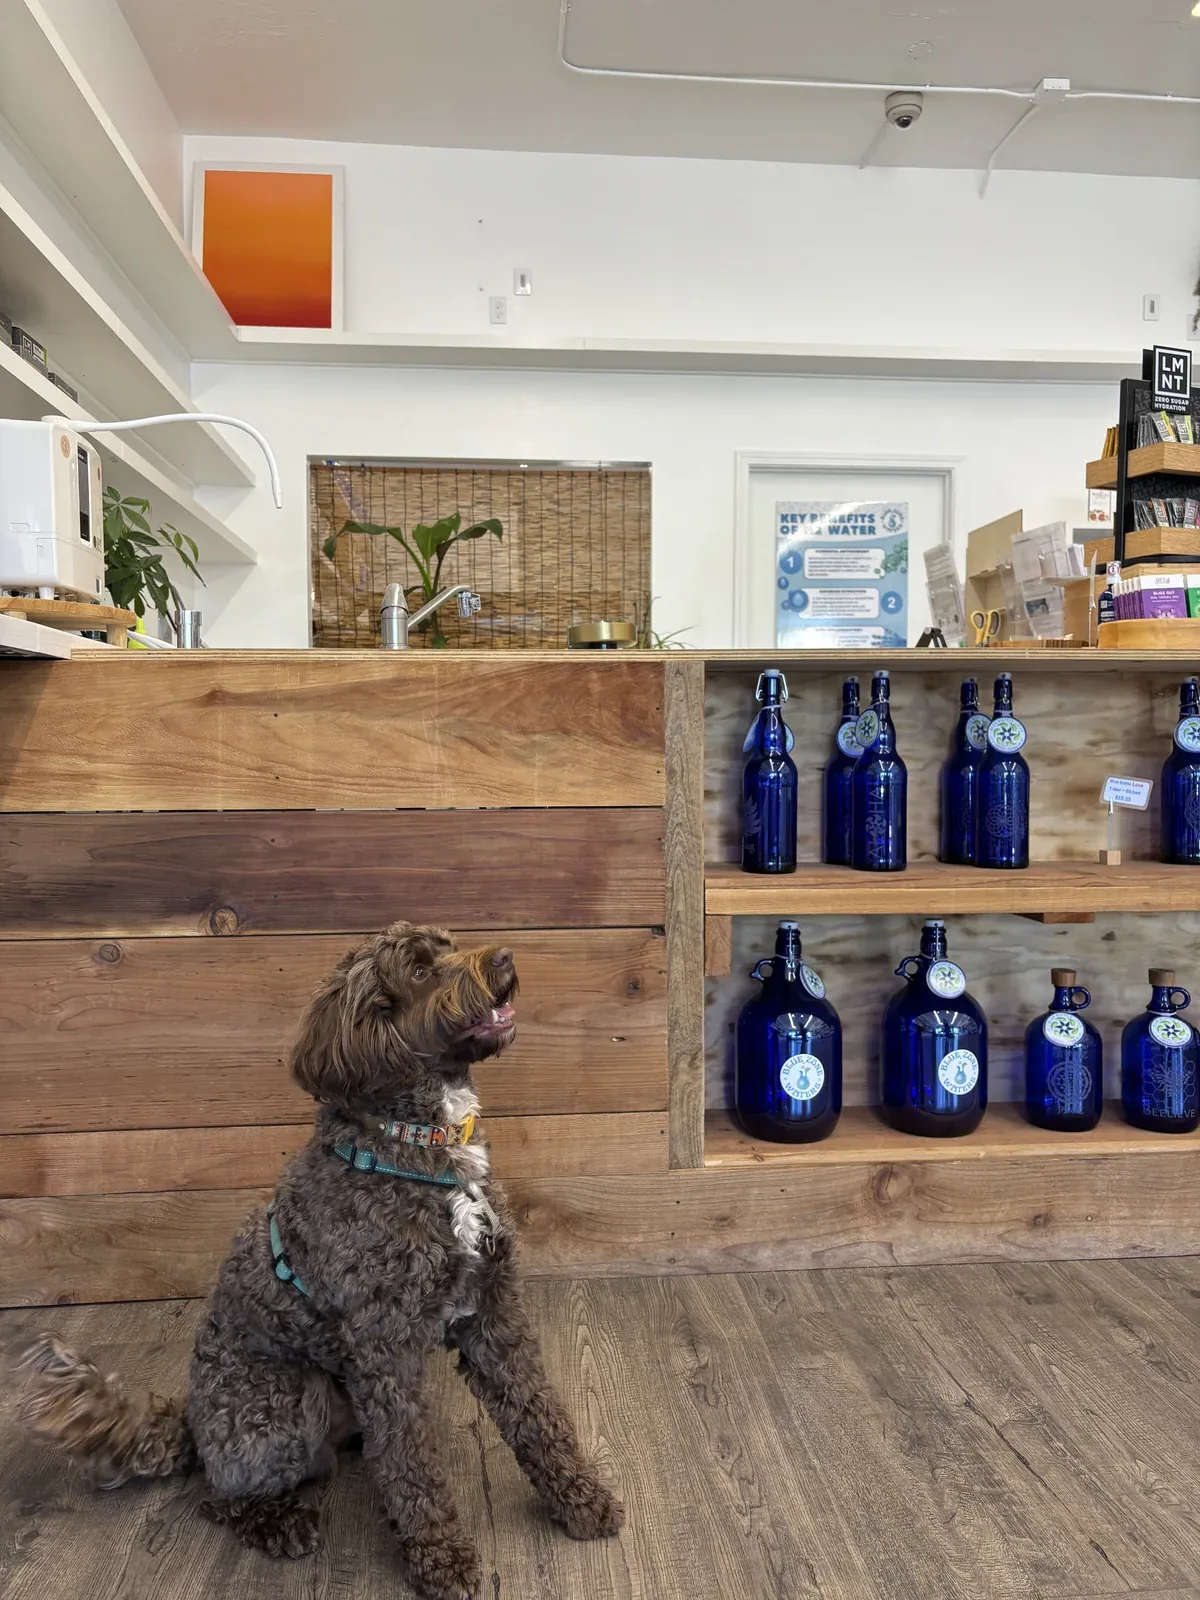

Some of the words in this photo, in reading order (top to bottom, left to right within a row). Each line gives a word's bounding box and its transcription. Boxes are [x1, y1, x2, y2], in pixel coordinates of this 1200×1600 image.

[1162, 355, 1184, 374] LM
[1162, 373, 1184, 391] NT
[1154, 403, 1187, 411] HYDRATION
[780, 513, 806, 524] KEY
[828, 525, 876, 535] WATER
[785, 556, 795, 569] 1
[887, 597, 896, 609] 2
[783, 1056, 803, 1075] BLUE
[806, 1056, 823, 1077] ZONE
[940, 1051, 961, 1071] BLUE
[962, 1051, 978, 1071] ZONE
[785, 1082, 821, 1099] WATERS
[943, 1077, 976, 1093] WATERS
